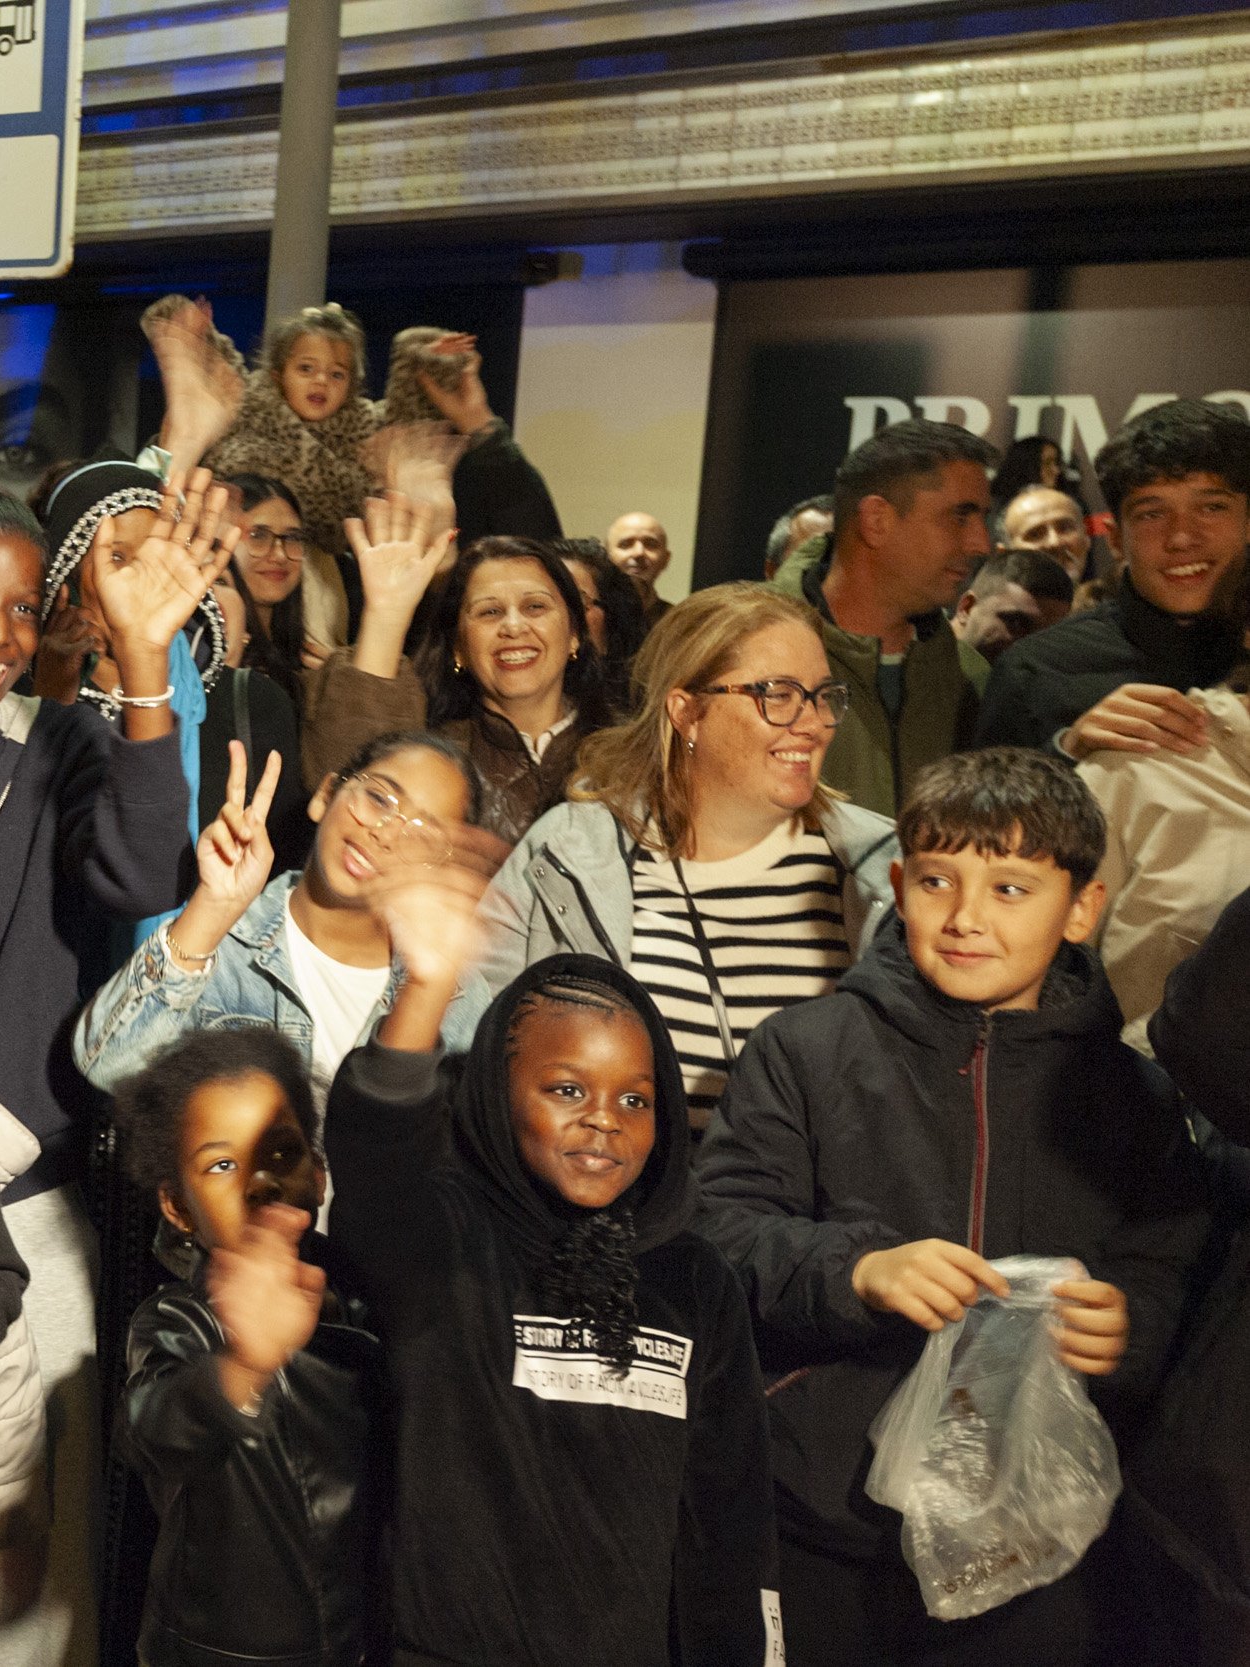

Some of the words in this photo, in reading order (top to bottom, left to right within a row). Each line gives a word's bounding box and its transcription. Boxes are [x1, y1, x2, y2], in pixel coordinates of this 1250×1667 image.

[522, 1325, 563, 1348] STORY
[527, 1369, 564, 1390] STORY
[567, 1372, 583, 1391] OF
